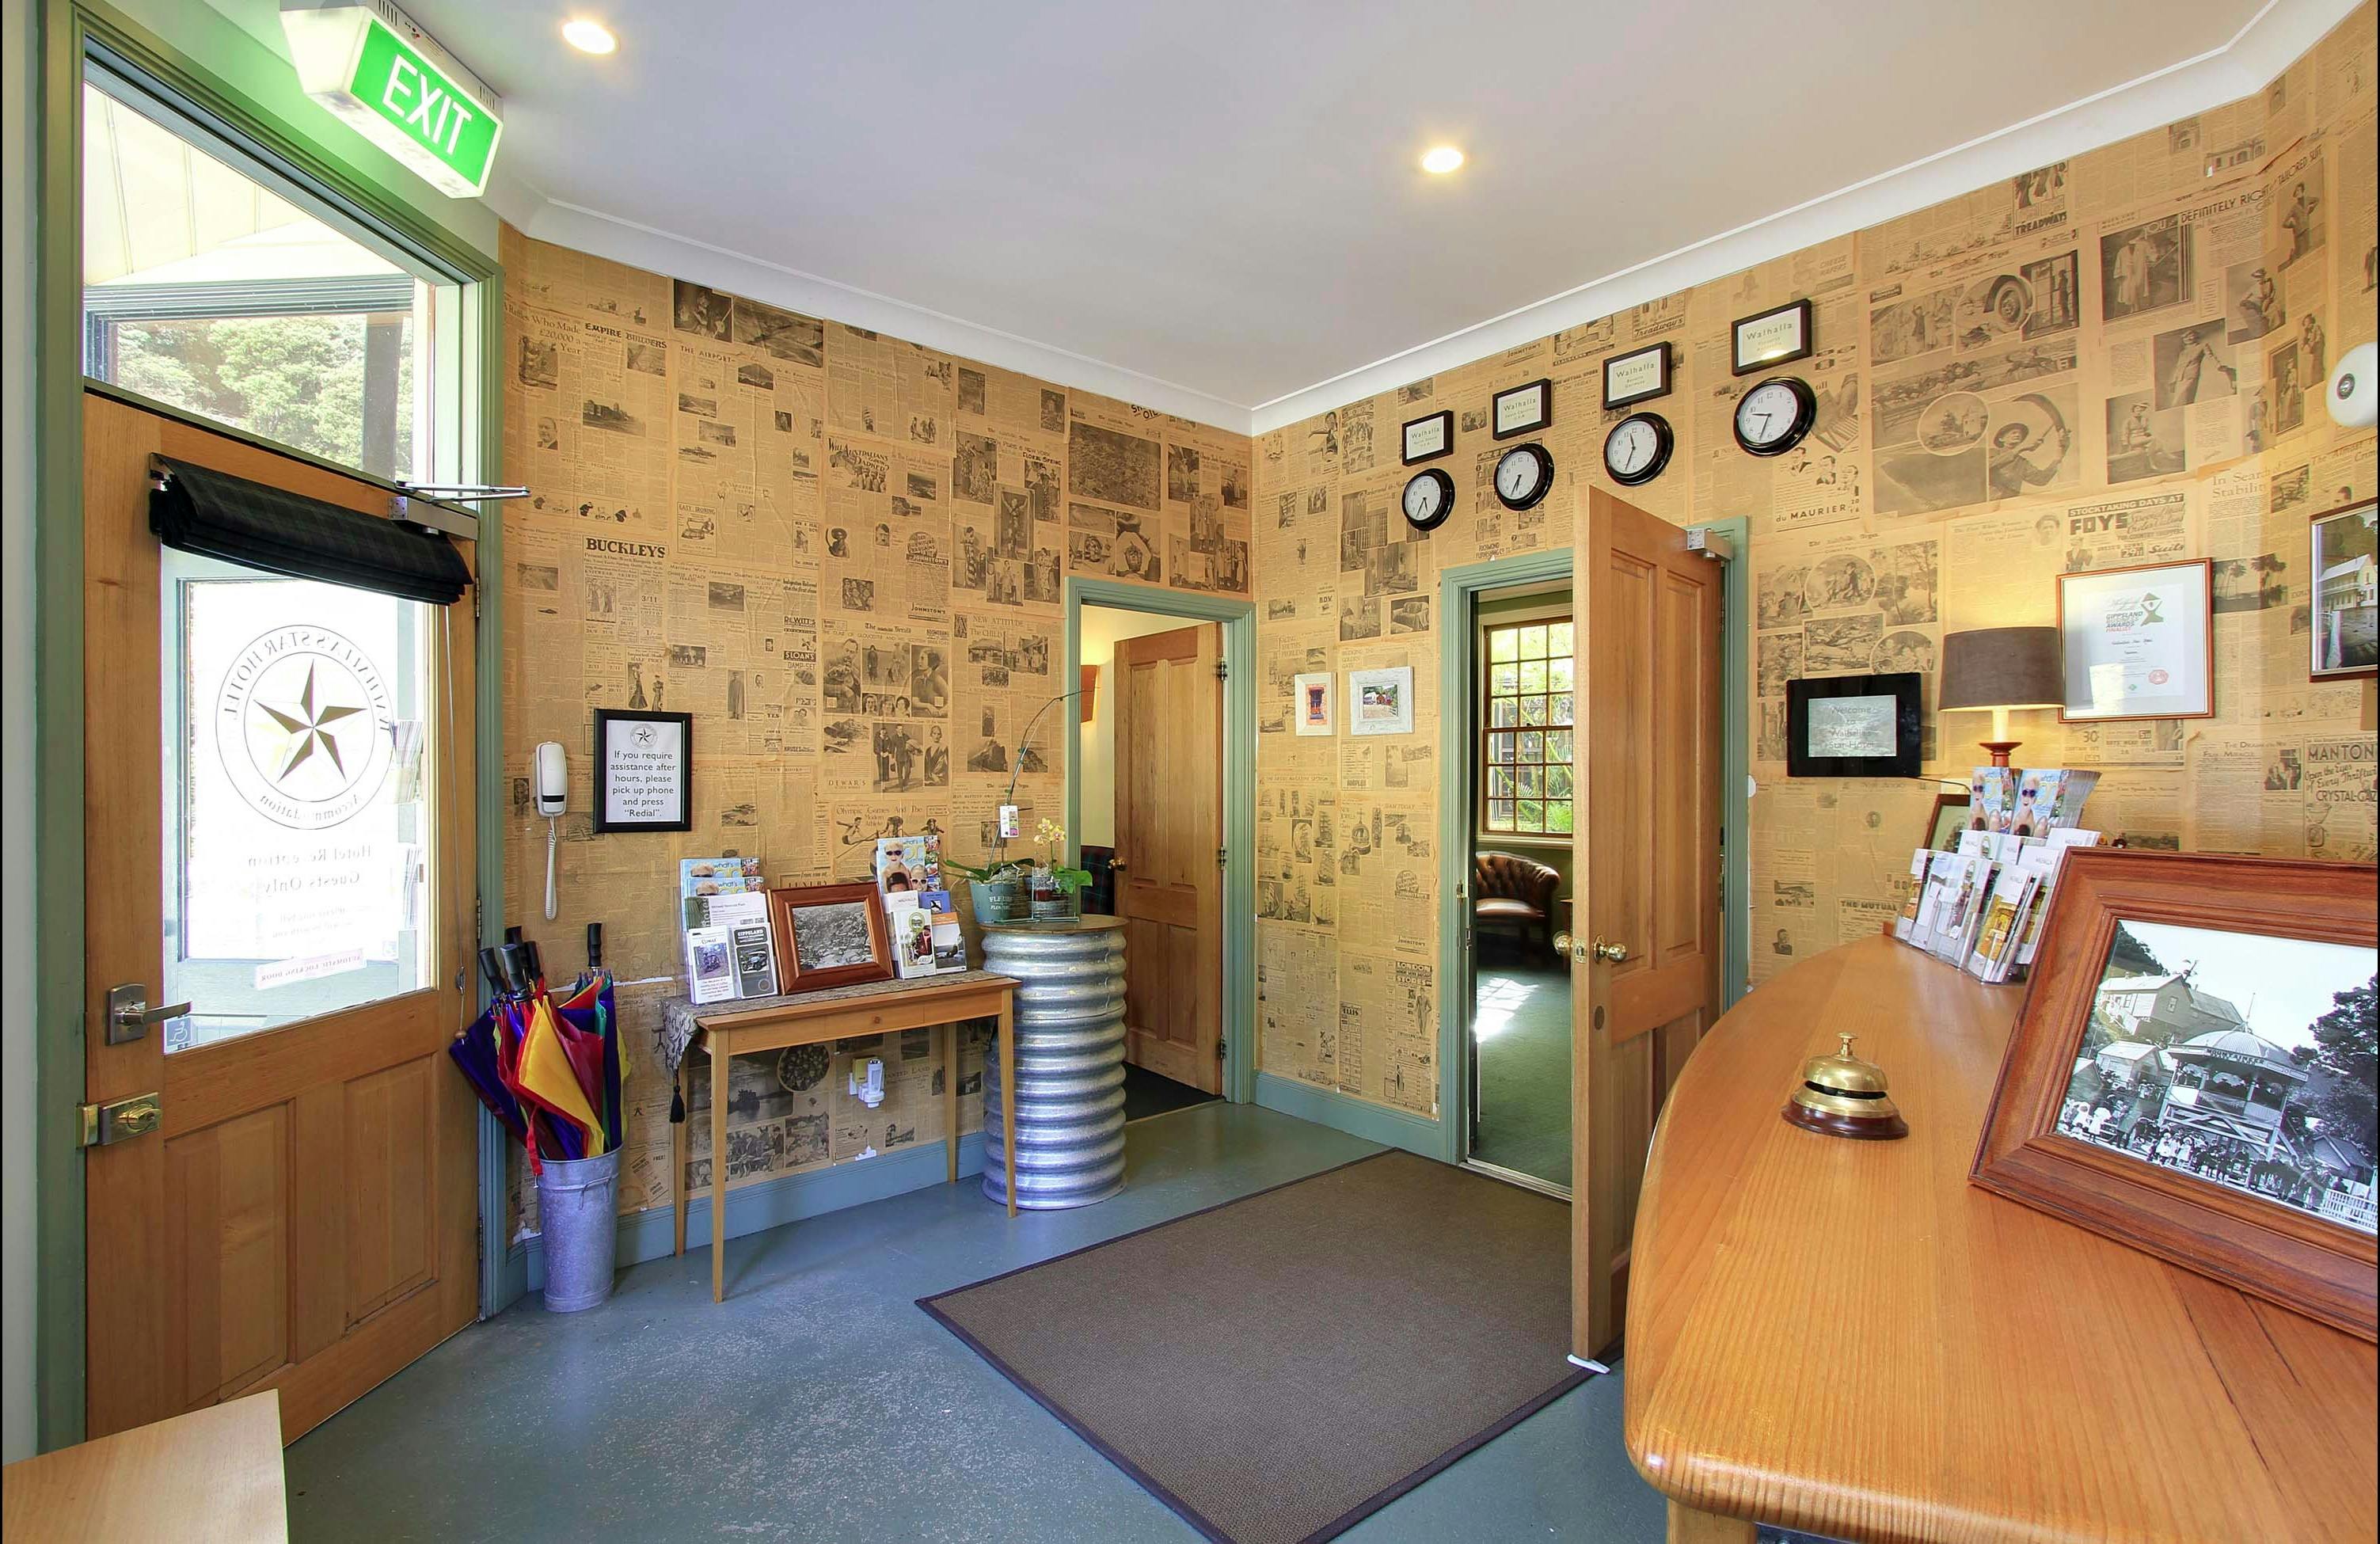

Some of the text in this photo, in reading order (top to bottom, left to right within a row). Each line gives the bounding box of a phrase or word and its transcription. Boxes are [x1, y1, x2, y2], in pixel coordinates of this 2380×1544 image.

[382, 54, 473, 155] EXIT
[2180, 199, 2237, 222] DEFINITELY
[2015, 211, 2066, 235] TREADWAYS
[532, 315, 555, 327] Who
[555, 321, 581, 334] Made
[539, 329, 574, 343] £20,000
[585, 322, 667, 349] EMPIRE BUILDERS
[1747, 323, 1793, 340] Walhalla
[560, 343, 581, 355] Year
[681, 345, 694, 355] THE
[1616, 363, 1655, 378] Walhalla
[1504, 397, 1536, 412] Walhalla
[1412, 427, 1439, 439] Walhalla
[2311, 455, 2326, 466] The
[2212, 476, 2226, 486] In
[2069, 494, 2183, 516] STOCKTAKING DAYS AT
[1790, 504, 1846, 520] MAURIER
[586, 538, 666, 558] BUCKLEYS
[2148, 543, 2185, 554] Suits
[2106, 610, 2143, 619] GIPPSLAND
[614, 750, 621, 759] If
[642, 752, 673, 761] require
[615, 774, 672, 784] hours, please
[2305, 770, 2324, 782] Open
[2324, 766, 2335, 776] the
[2317, 777, 2340, 789] Every
[613, 786, 630, 795] pick
[648, 786, 674, 795] phone
[836, 807, 862, 816] Olympic
[1861, 901, 1898, 911] MUTUAL
